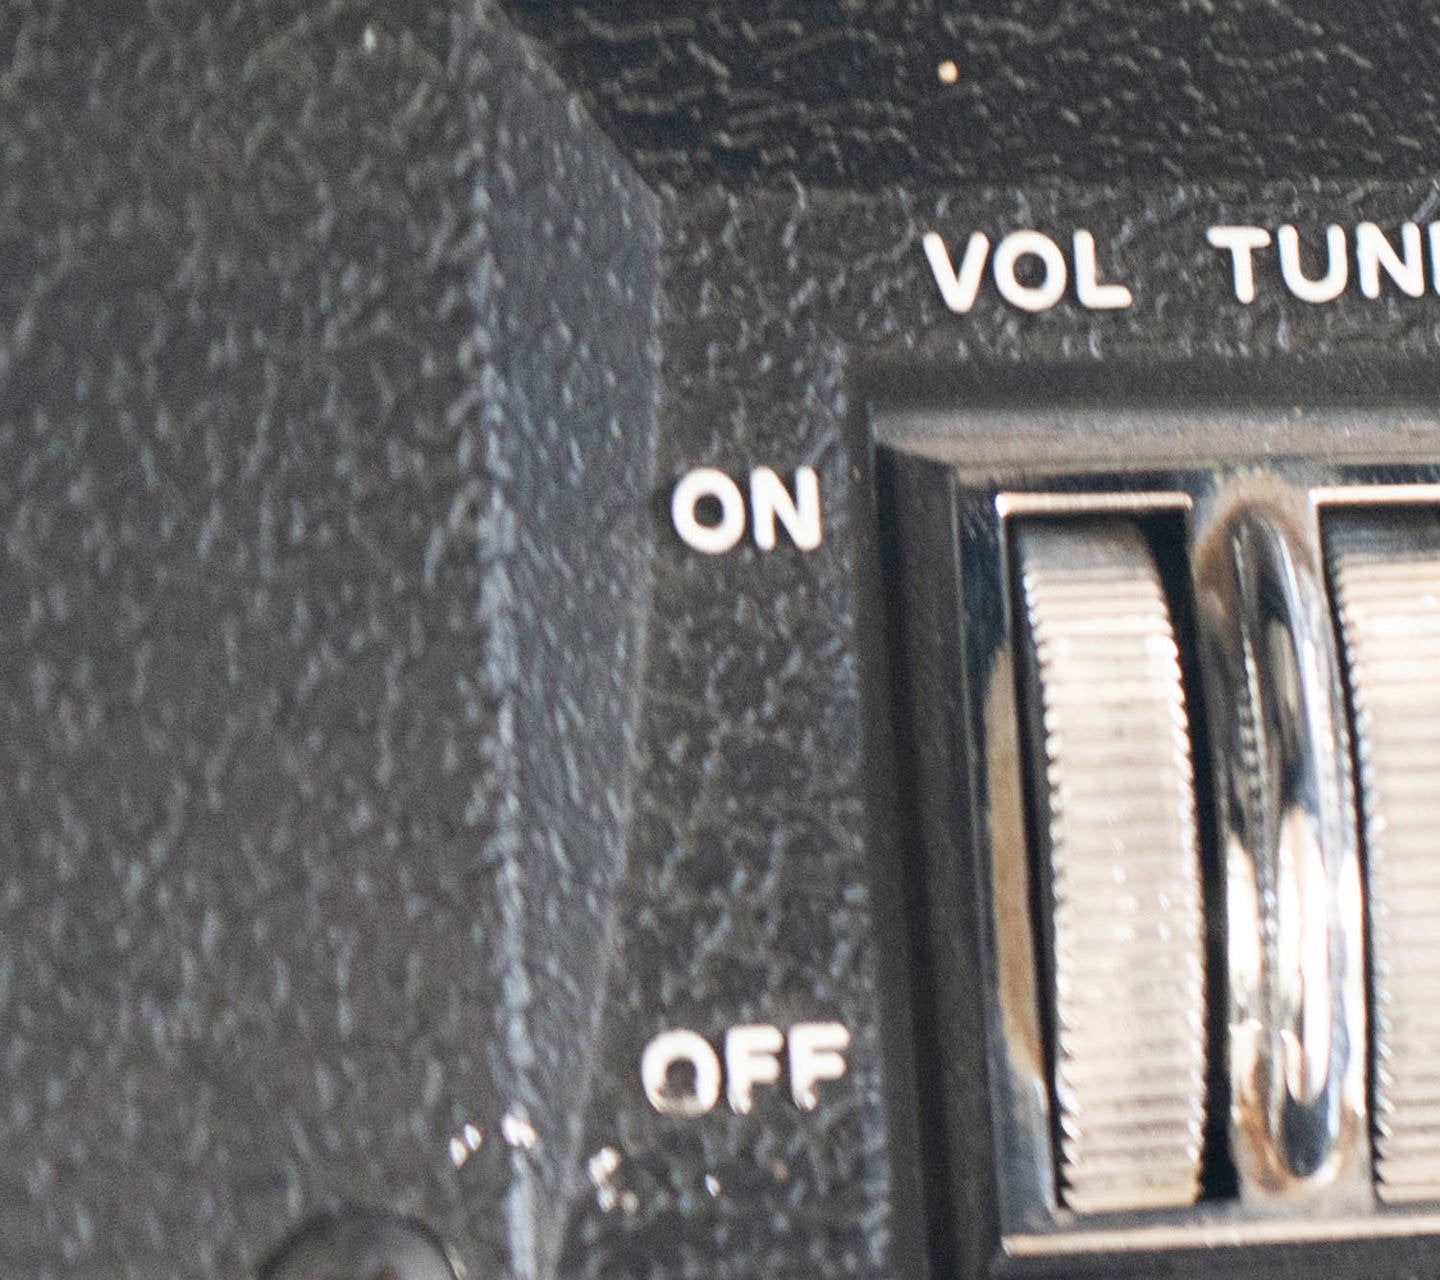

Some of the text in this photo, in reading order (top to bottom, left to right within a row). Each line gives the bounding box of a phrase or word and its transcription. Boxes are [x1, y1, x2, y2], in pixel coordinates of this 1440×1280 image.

[924, 229, 1132, 313] VOL
[670, 466, 822, 553] ON
[641, 1022, 850, 1118] OFF
